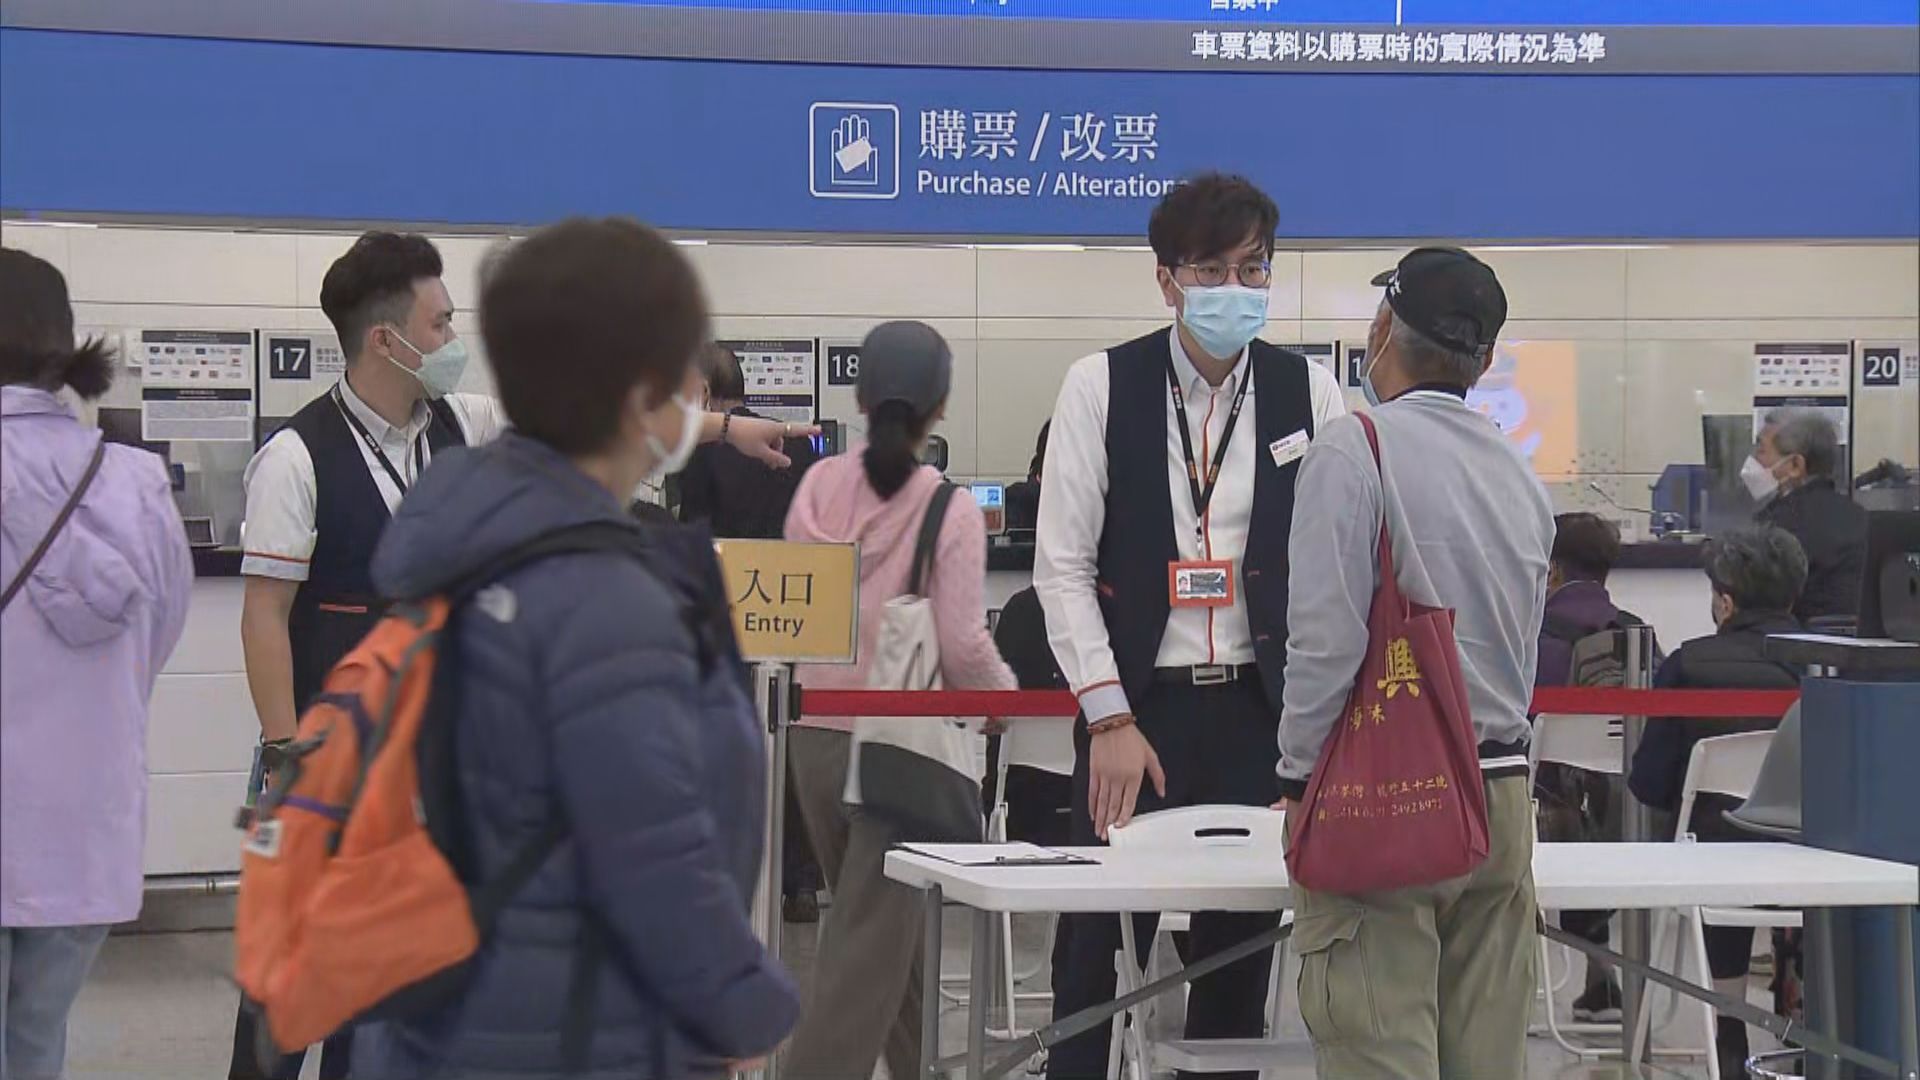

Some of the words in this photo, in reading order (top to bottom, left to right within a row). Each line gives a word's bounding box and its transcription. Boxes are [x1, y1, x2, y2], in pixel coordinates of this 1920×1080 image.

[1192, 30, 1605, 63] 車票資料以購票時的實際情況為準
[917, 170, 1031, 196] Purchase
[1036, 172, 1048, 197] /
[1053, 172, 1188, 198] Alteration
[273, 347, 306, 371] 17
[832, 354, 860, 378] 18
[1352, 356, 1361, 379] 1
[1866, 355, 1897, 378] 20
[737, 568, 813, 605] 入口
[745, 612, 804, 638] Entry
